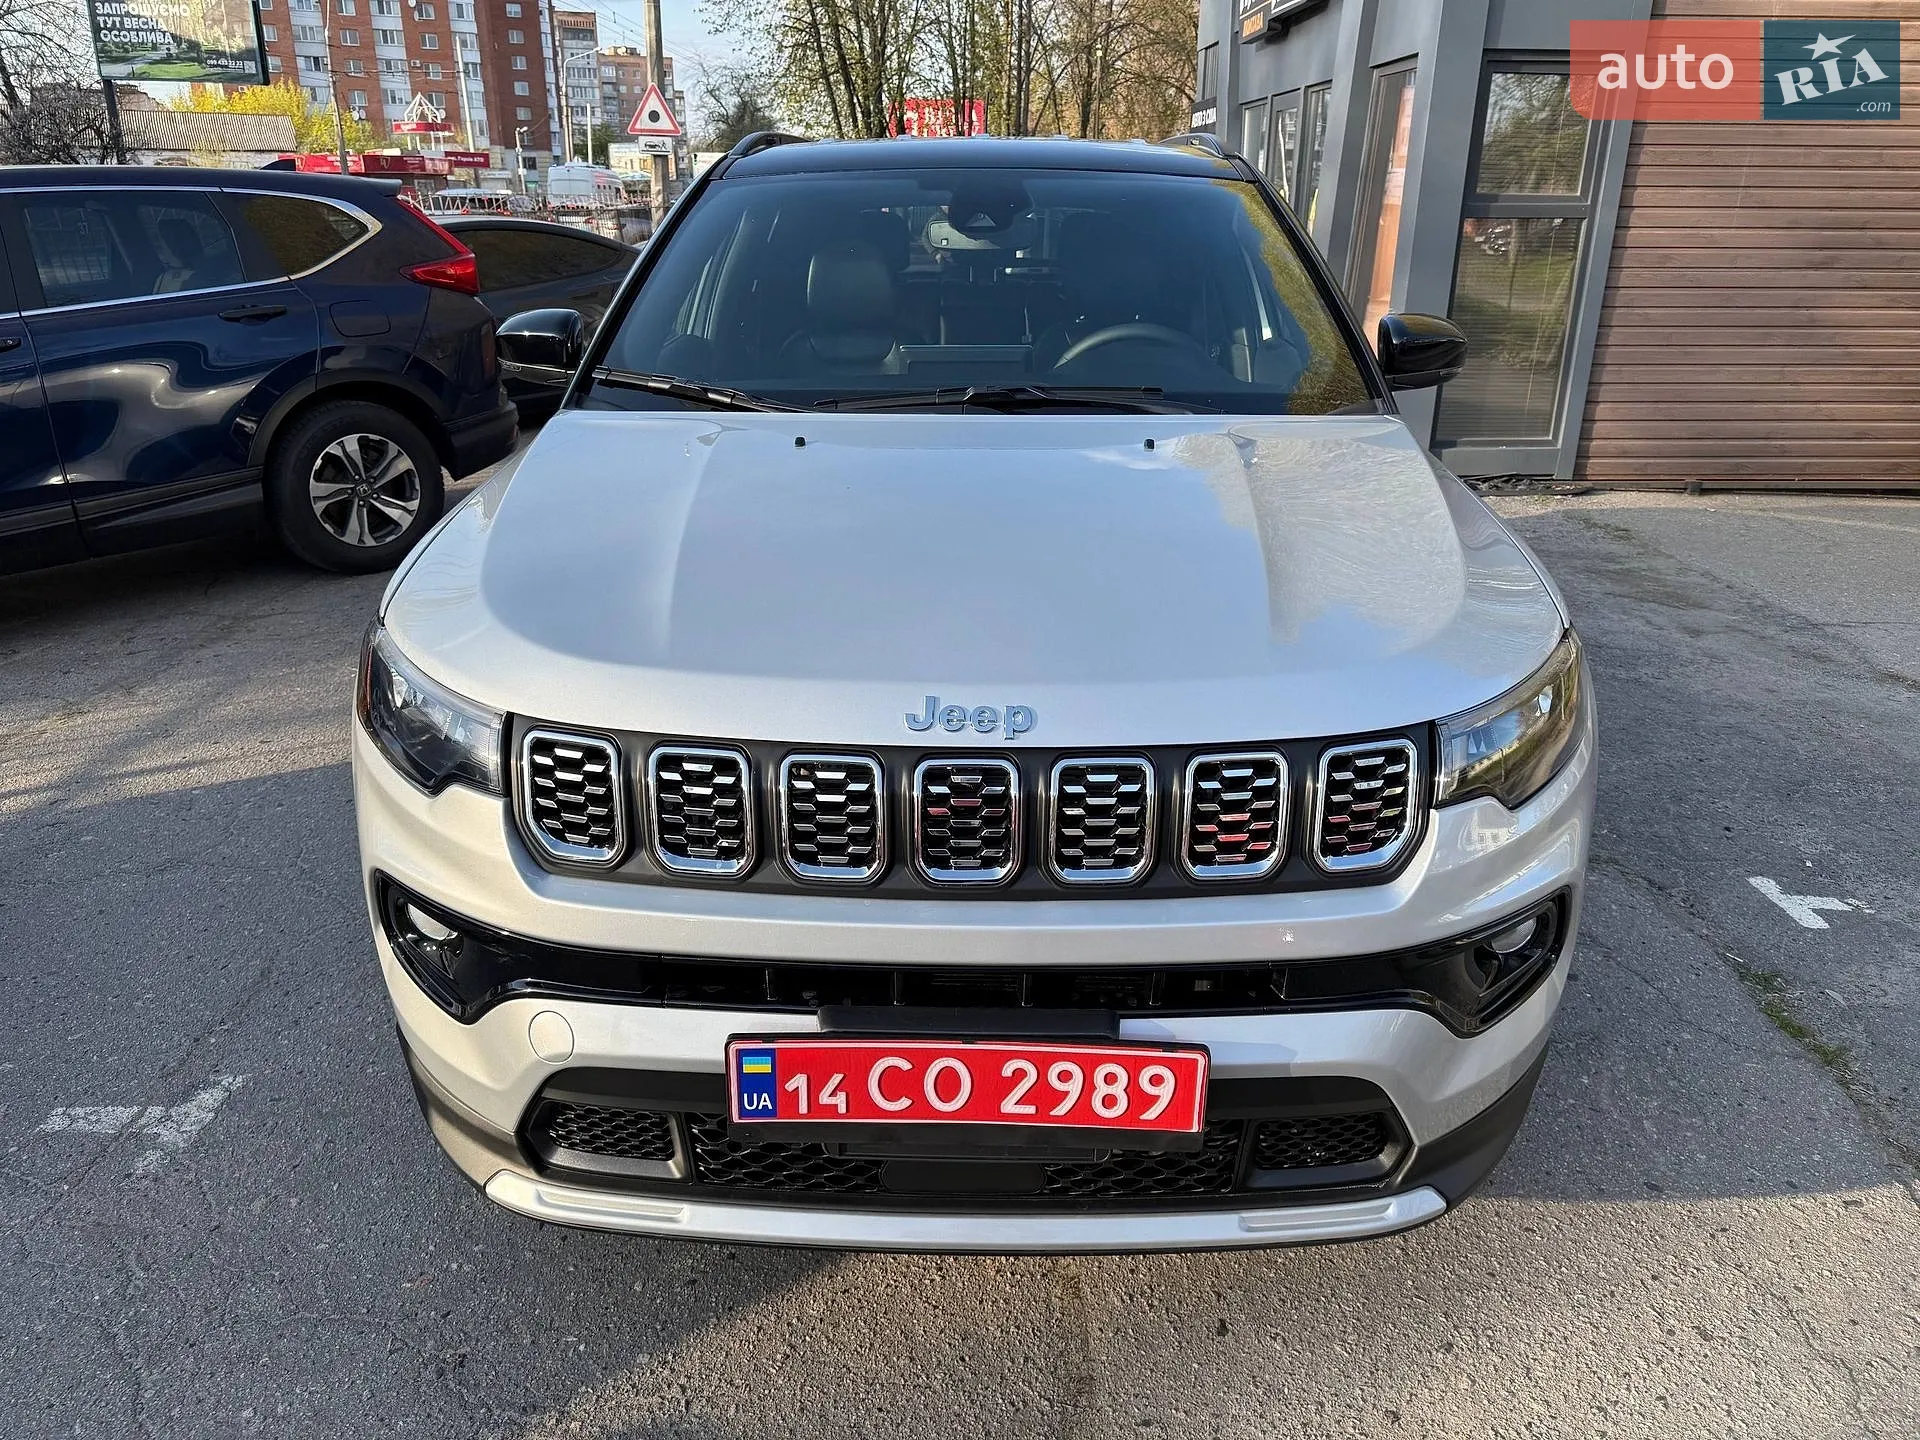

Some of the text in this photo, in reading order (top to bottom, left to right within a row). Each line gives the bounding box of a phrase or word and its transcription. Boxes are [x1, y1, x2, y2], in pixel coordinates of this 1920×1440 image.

[96, 2, 191, 16] ЗАПРОШУЄМО
[97, 16, 167, 31] ТУТ ВЕСНА
[100, 30, 174, 44] ОСОБЛИВА
[904, 695, 1038, 741] Jeep
[784, 1056, 1177, 1121] 14 CO 2989
[743, 1093, 773, 1111] UA
